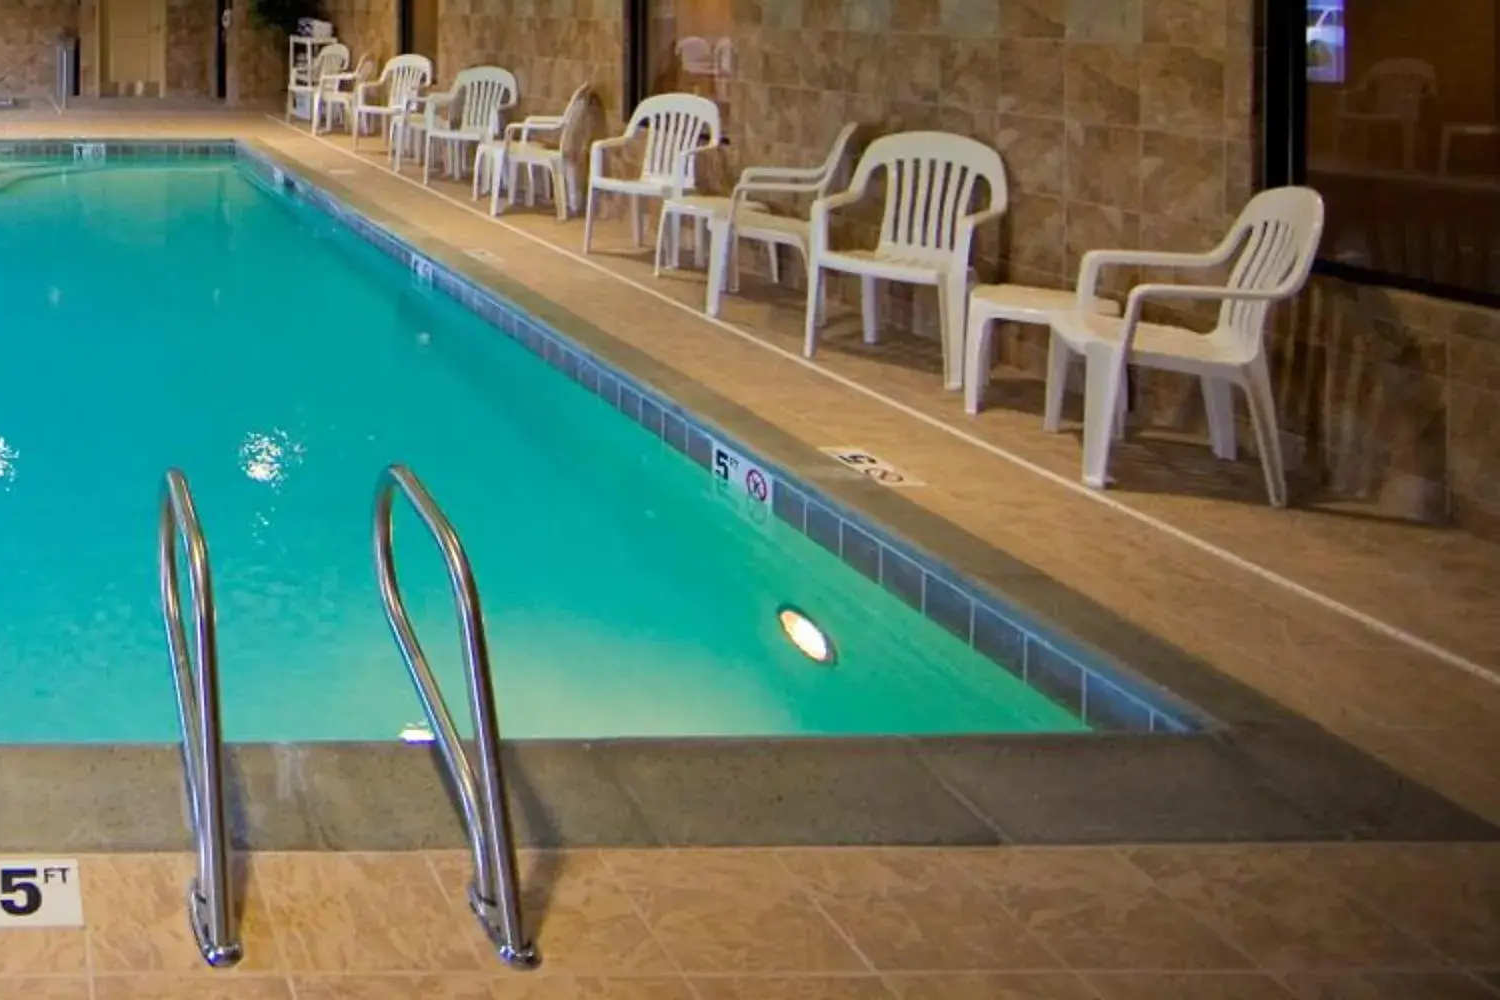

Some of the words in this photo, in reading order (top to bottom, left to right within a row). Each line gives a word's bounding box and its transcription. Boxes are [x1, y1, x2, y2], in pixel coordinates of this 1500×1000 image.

[715, 449, 729, 481] 5
[0, 868, 42, 916] 5
[43, 867, 71, 884] FT
